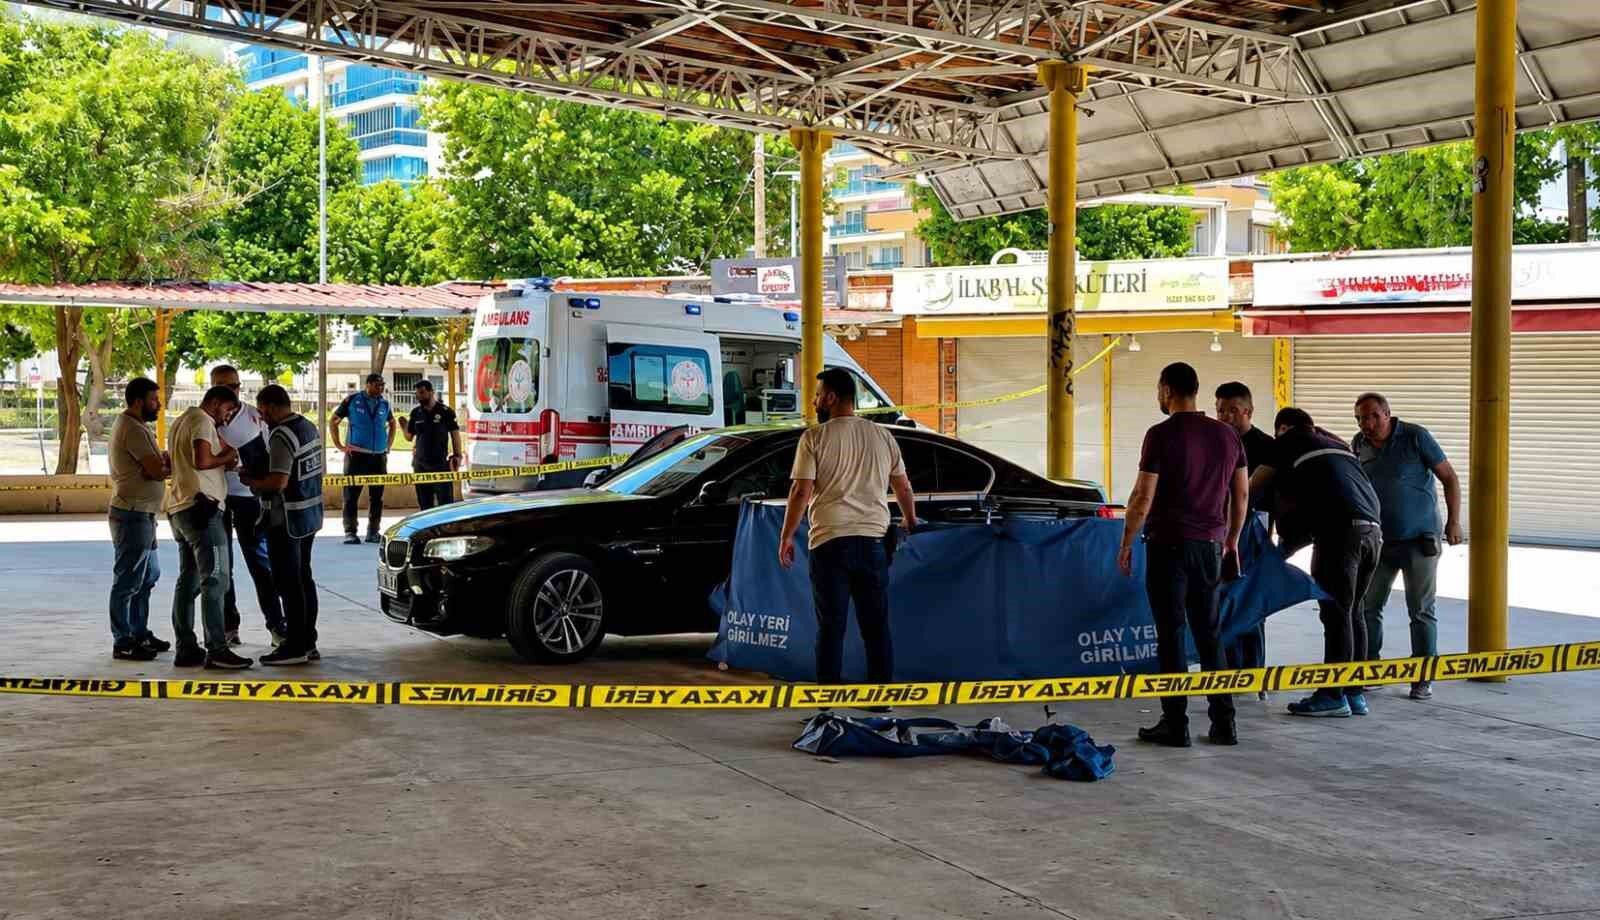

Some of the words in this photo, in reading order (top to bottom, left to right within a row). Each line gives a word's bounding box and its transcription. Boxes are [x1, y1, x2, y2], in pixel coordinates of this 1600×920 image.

[481, 310, 530, 327] AMBULANS
[727, 610, 756, 627] OLAY
[759, 613, 791, 632] YERİ
[727, 626, 788, 649] GİRİLMEZ
[1078, 628, 1125, 646] OLAY
[1130, 624, 1159, 640] YE
[1080, 643, 1159, 664] GİRİLME
